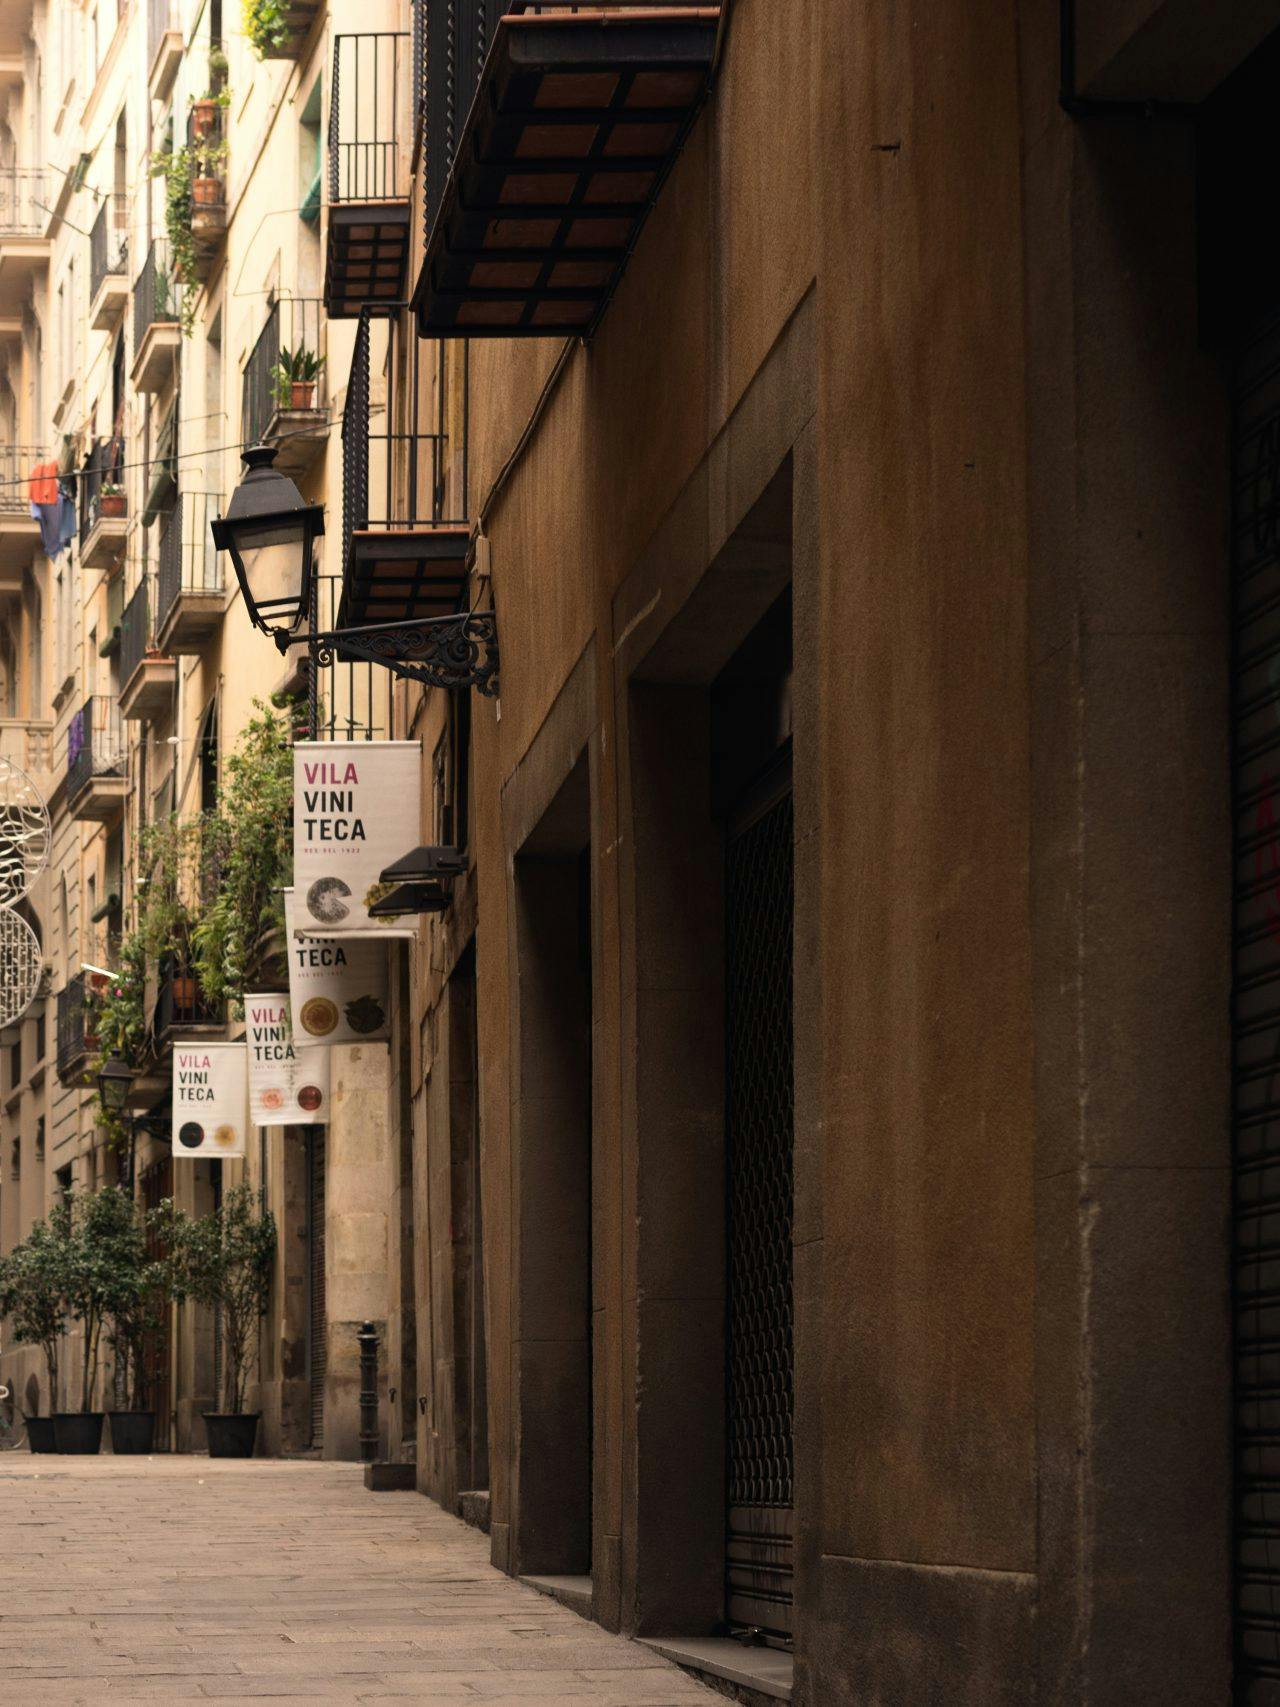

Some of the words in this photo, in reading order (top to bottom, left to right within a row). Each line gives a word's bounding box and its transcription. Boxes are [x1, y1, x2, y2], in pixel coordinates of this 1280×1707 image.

[304, 763, 358, 784] VILA
[304, 791, 353, 812] VINI
[304, 819, 366, 840] TECA
[296, 947, 347, 967] TECA
[252, 1008, 288, 1023] VILA
[253, 1026, 285, 1042] VINI
[253, 1043, 295, 1061] TECA
[179, 1055, 211, 1068] VILA
[179, 1071, 208, 1084] VINI
[178, 1087, 215, 1101] TECA
